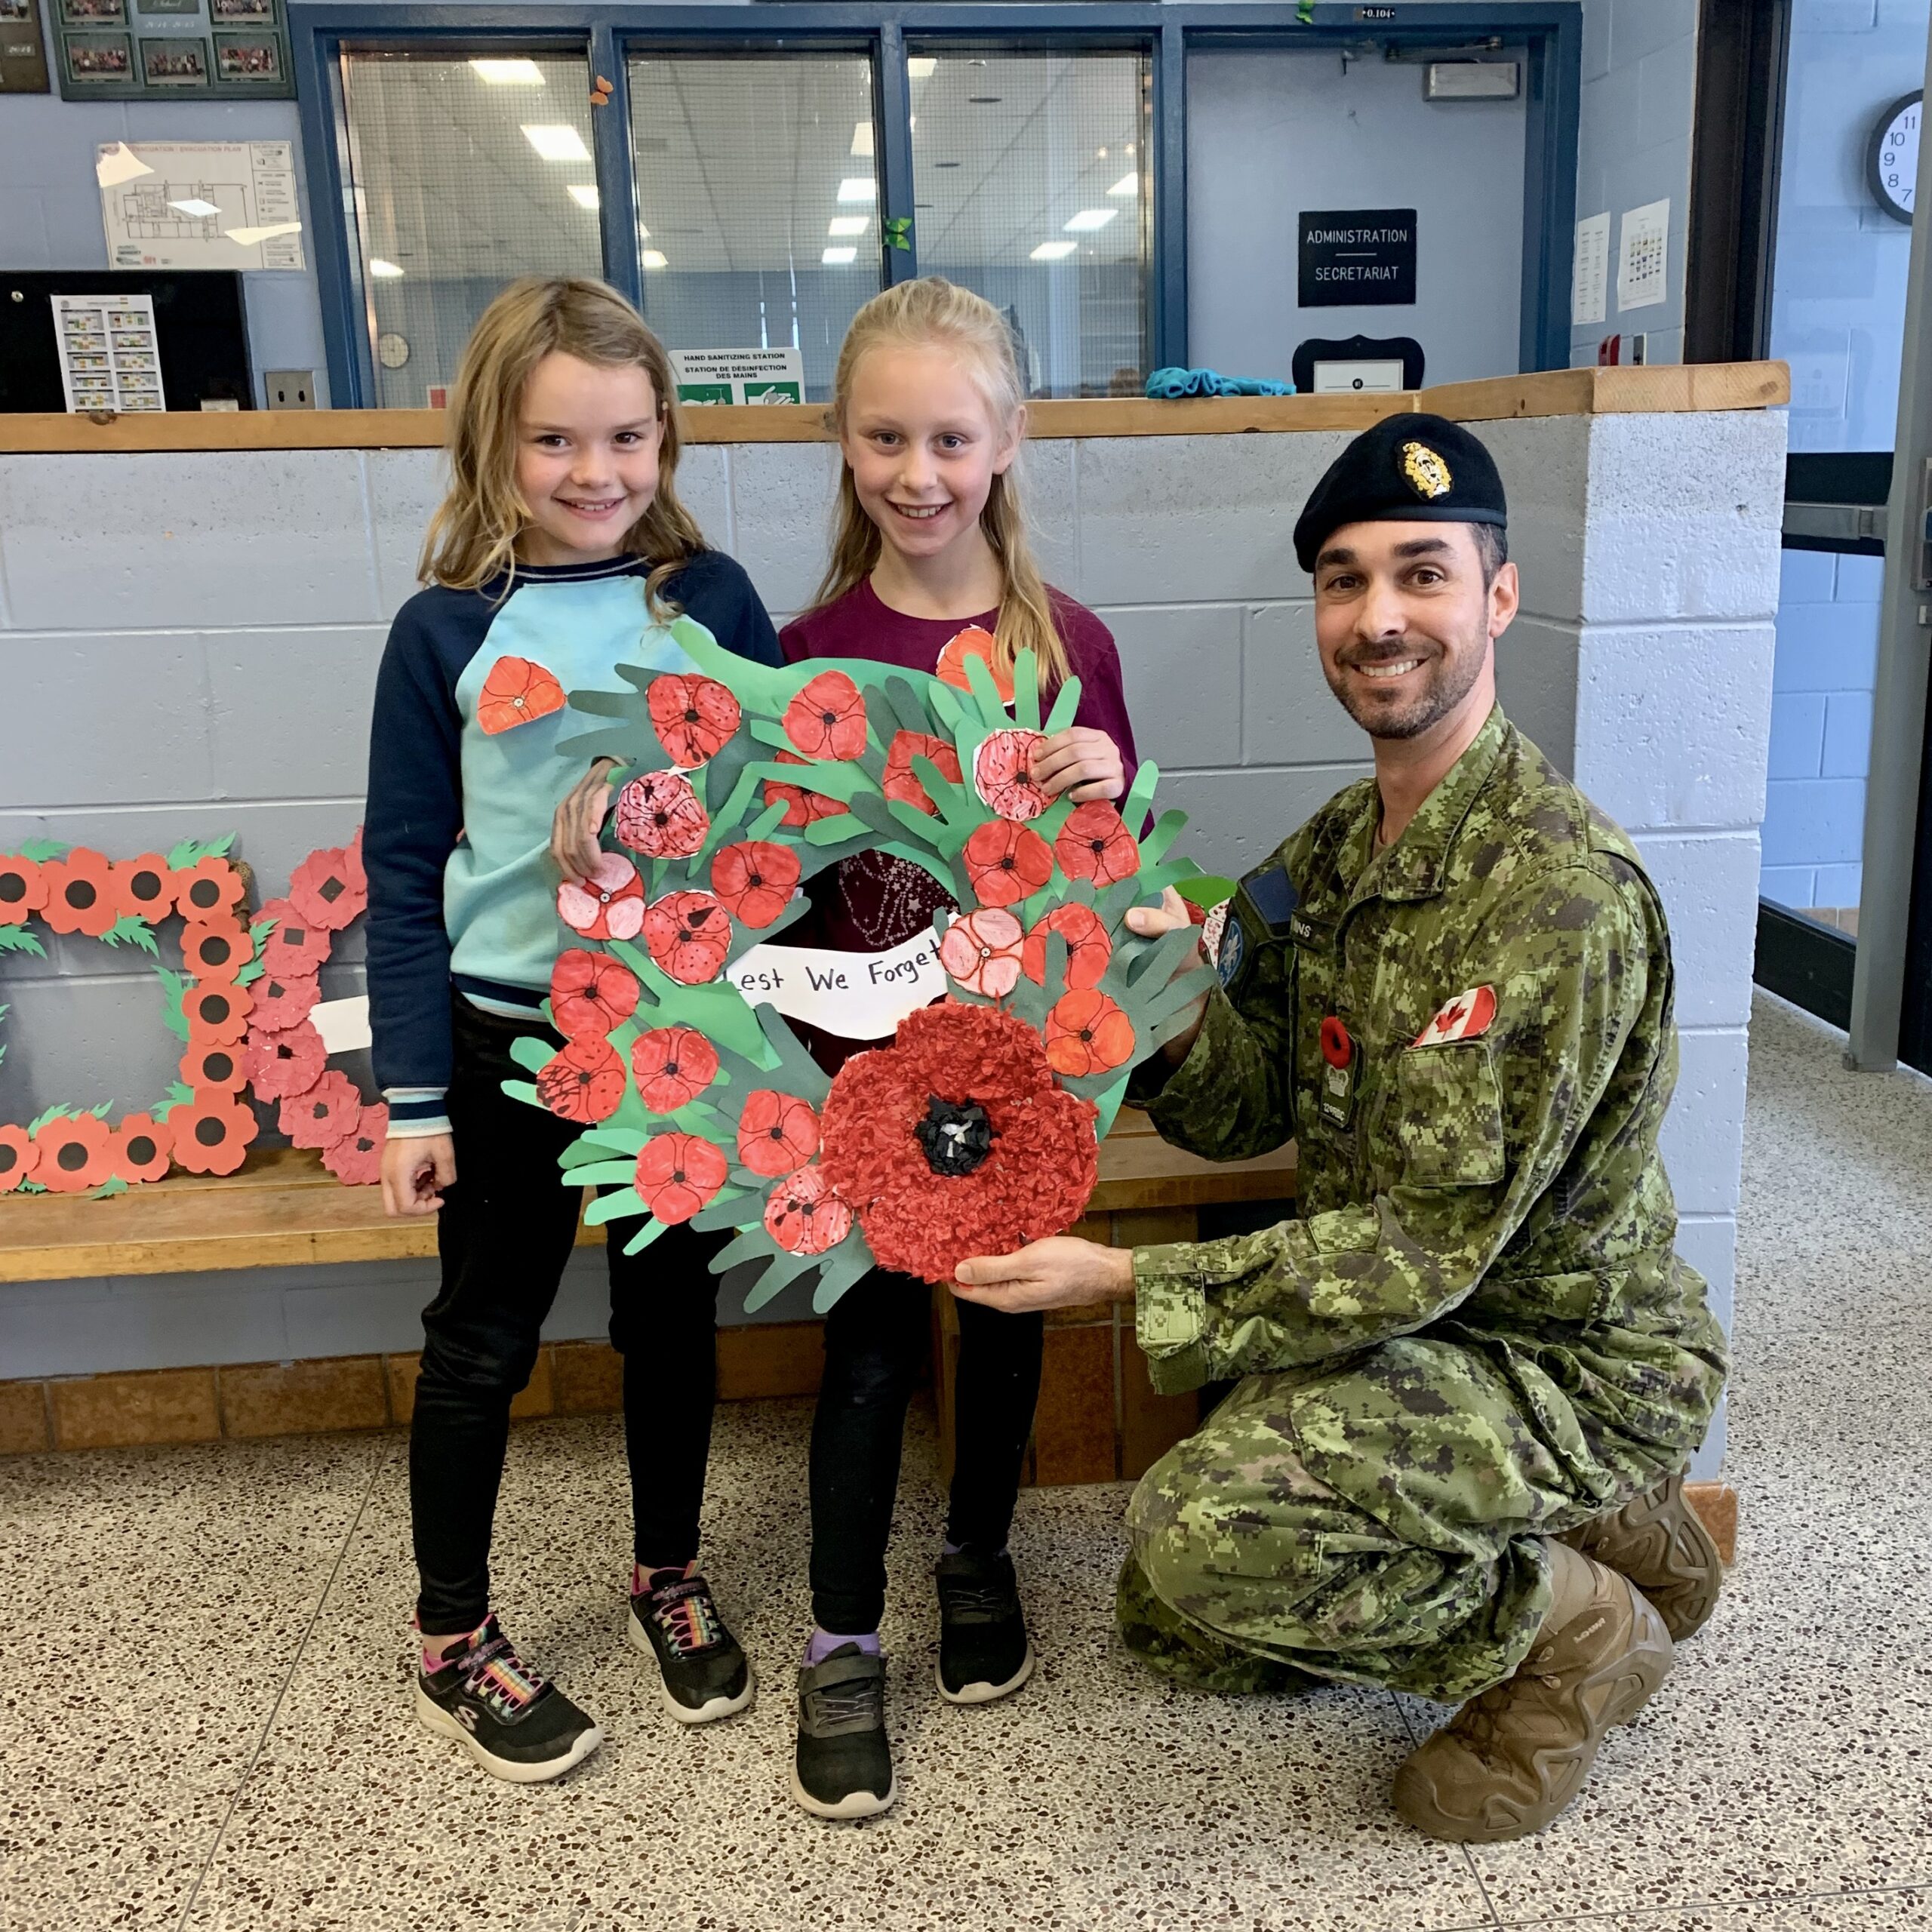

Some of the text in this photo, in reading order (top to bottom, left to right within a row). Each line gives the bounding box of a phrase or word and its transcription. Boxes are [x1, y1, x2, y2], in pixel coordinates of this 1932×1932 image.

[1904, 115, 1915, 129] 11
[1890, 132, 1905, 146] 10
[1884, 152, 1895, 166] 9
[1887, 174, 1899, 187] 8
[1902, 189, 1912, 202] 7
[1306, 229, 1407, 244] ADMINISTRATION
[1315, 266, 1398, 281] SECRETARIAT
[805, 966, 849, 991] We
[868, 939, 940, 984] Forget
[1574, 1617, 1606, 1644] LOWA
